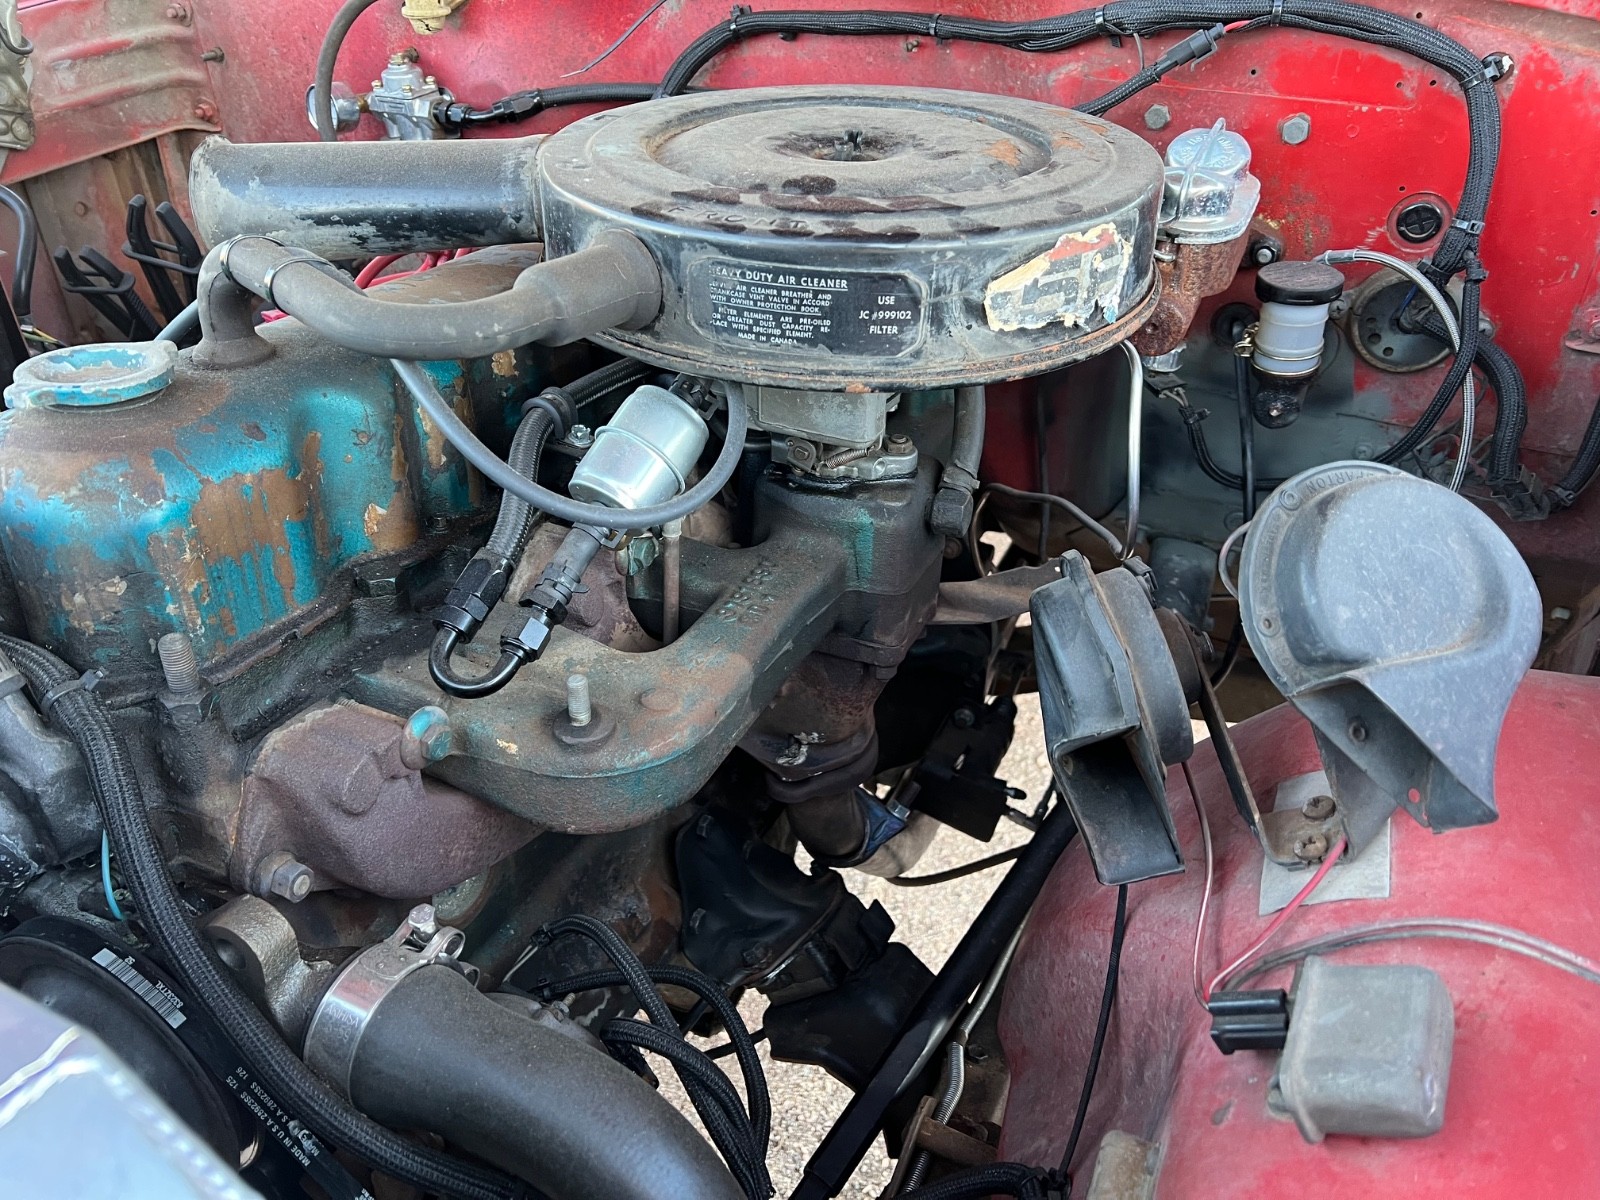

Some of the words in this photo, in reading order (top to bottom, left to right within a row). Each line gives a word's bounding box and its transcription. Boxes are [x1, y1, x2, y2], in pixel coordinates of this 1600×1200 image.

[666, 205, 808, 230] FRONT
[746, 271, 773, 283] DUTY
[778, 274, 796, 285] AIR
[800, 277, 848, 289] CLEANER
[736, 284, 747, 292] AIR
[750, 286, 778, 296] CLEANER
[781, 290, 814, 299] BREATHER
[749, 292, 765, 301] VENT
[768, 295, 789, 304] VALVE
[710, 293, 727, 302] WITH
[730, 297, 754, 306] OWNER
[757, 301, 797, 311] PROTECTION
[877, 296, 896, 305] USE
[711, 312, 721, 320] OR
[727, 315, 753, 325] GREATER
[759, 320, 776, 328] DUST
[781, 322, 814, 332] CAPACITY
[743, 310, 773, 321] ELEMENTS
[780, 315, 793, 323] ARE
[859, 310, 870, 320] JC
[871, 310, 912, 321] #999102
[731, 322, 749, 331] WITH
[752, 325, 781, 336] SPECIFIED
[737, 331, 756, 341] MADE
[869, 325, 898, 335] FILTER
[235, 1066, 249, 1081] 126
[225, 1075, 239, 1090] 125
[282, 1136, 293, 1148] IN
[290, 1144, 311, 1167] MADE
